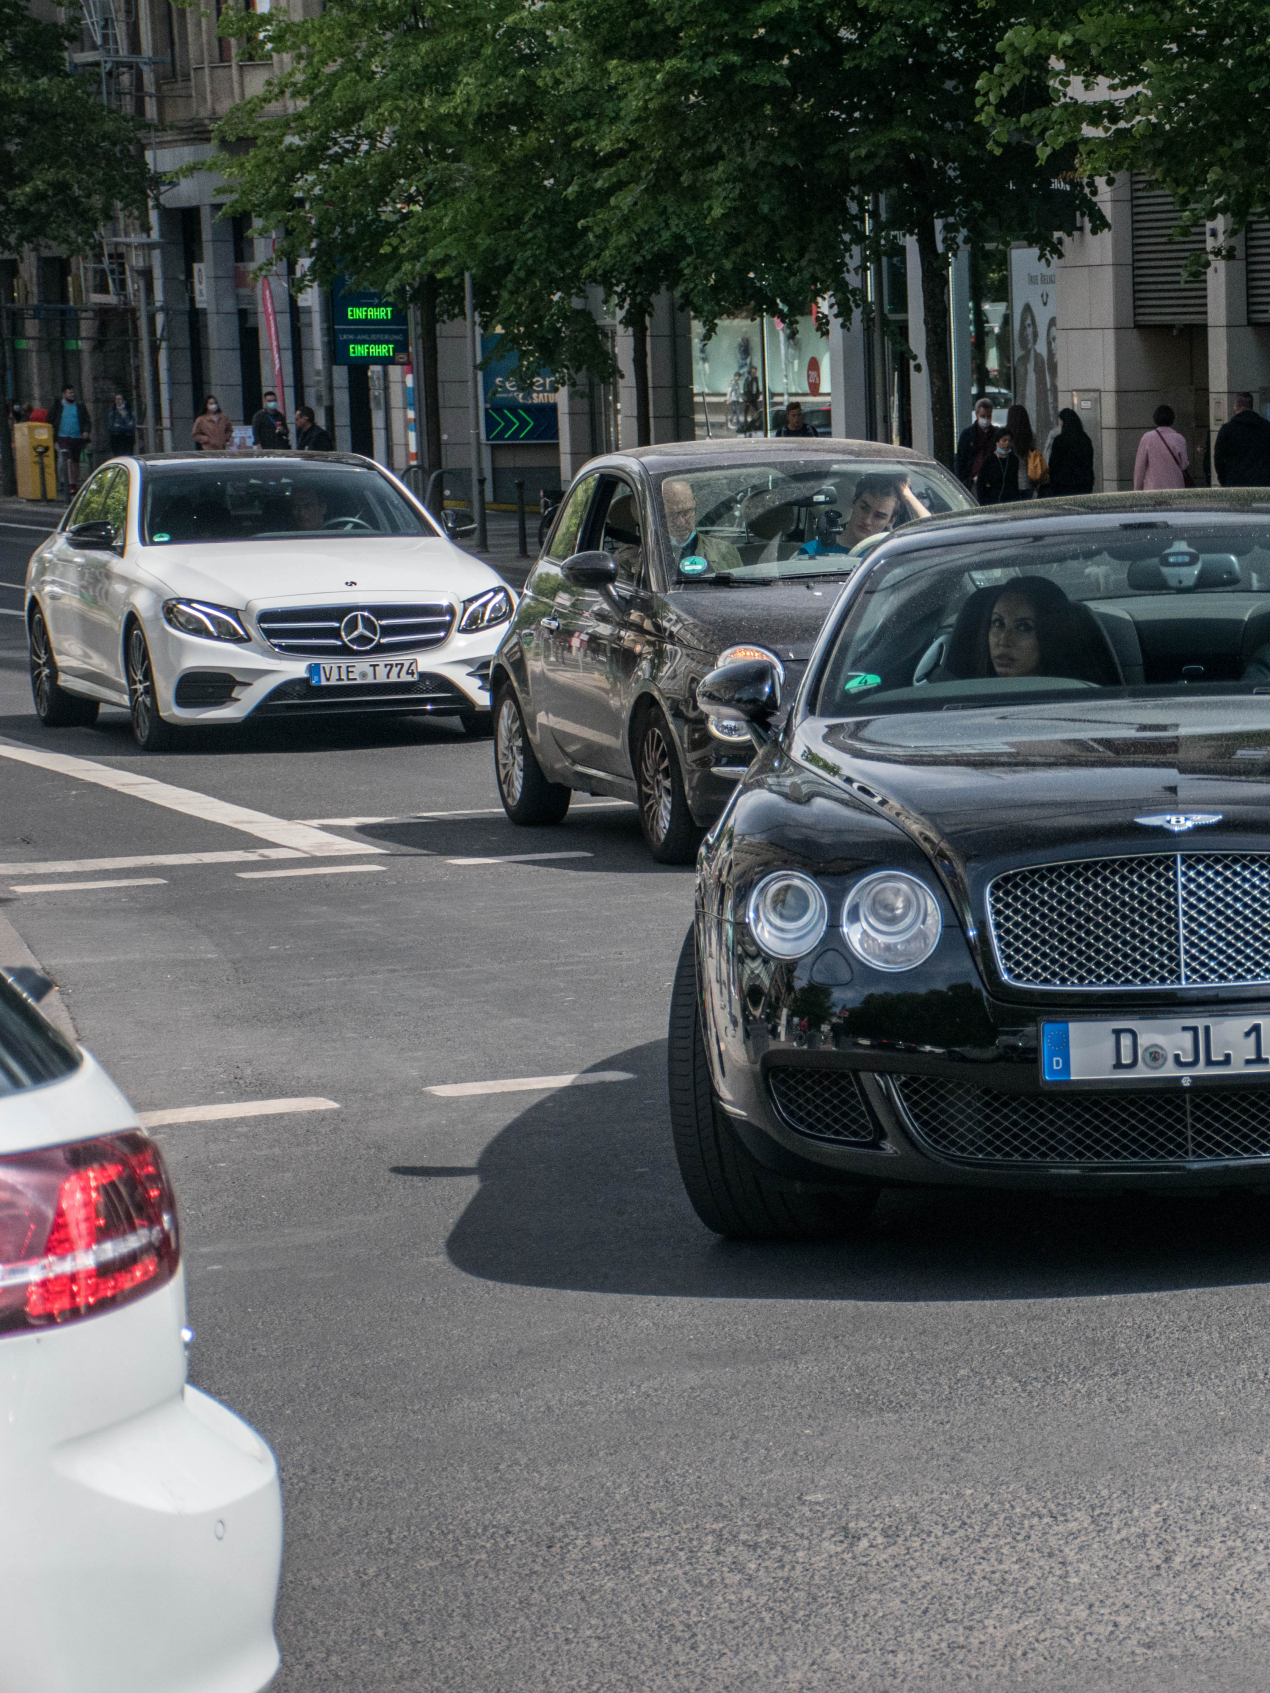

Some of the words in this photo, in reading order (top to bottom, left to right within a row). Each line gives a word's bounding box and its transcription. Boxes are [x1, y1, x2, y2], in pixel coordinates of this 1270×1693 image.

[347, 306, 393, 320] EINFAHRT
[349, 344, 395, 357] EINFAHRT
[690, 558, 697, 566] 4
[322, 664, 358, 682] VIE
[369, 663, 380, 680] T
[384, 660, 416, 680] 774
[858, 675, 868, 685] 4
[1053, 1057, 1063, 1070] D
[1111, 1027, 1139, 1070] D
[1173, 1024, 1232, 1068] JL
[1243, 1022, 1270, 1065] 1
